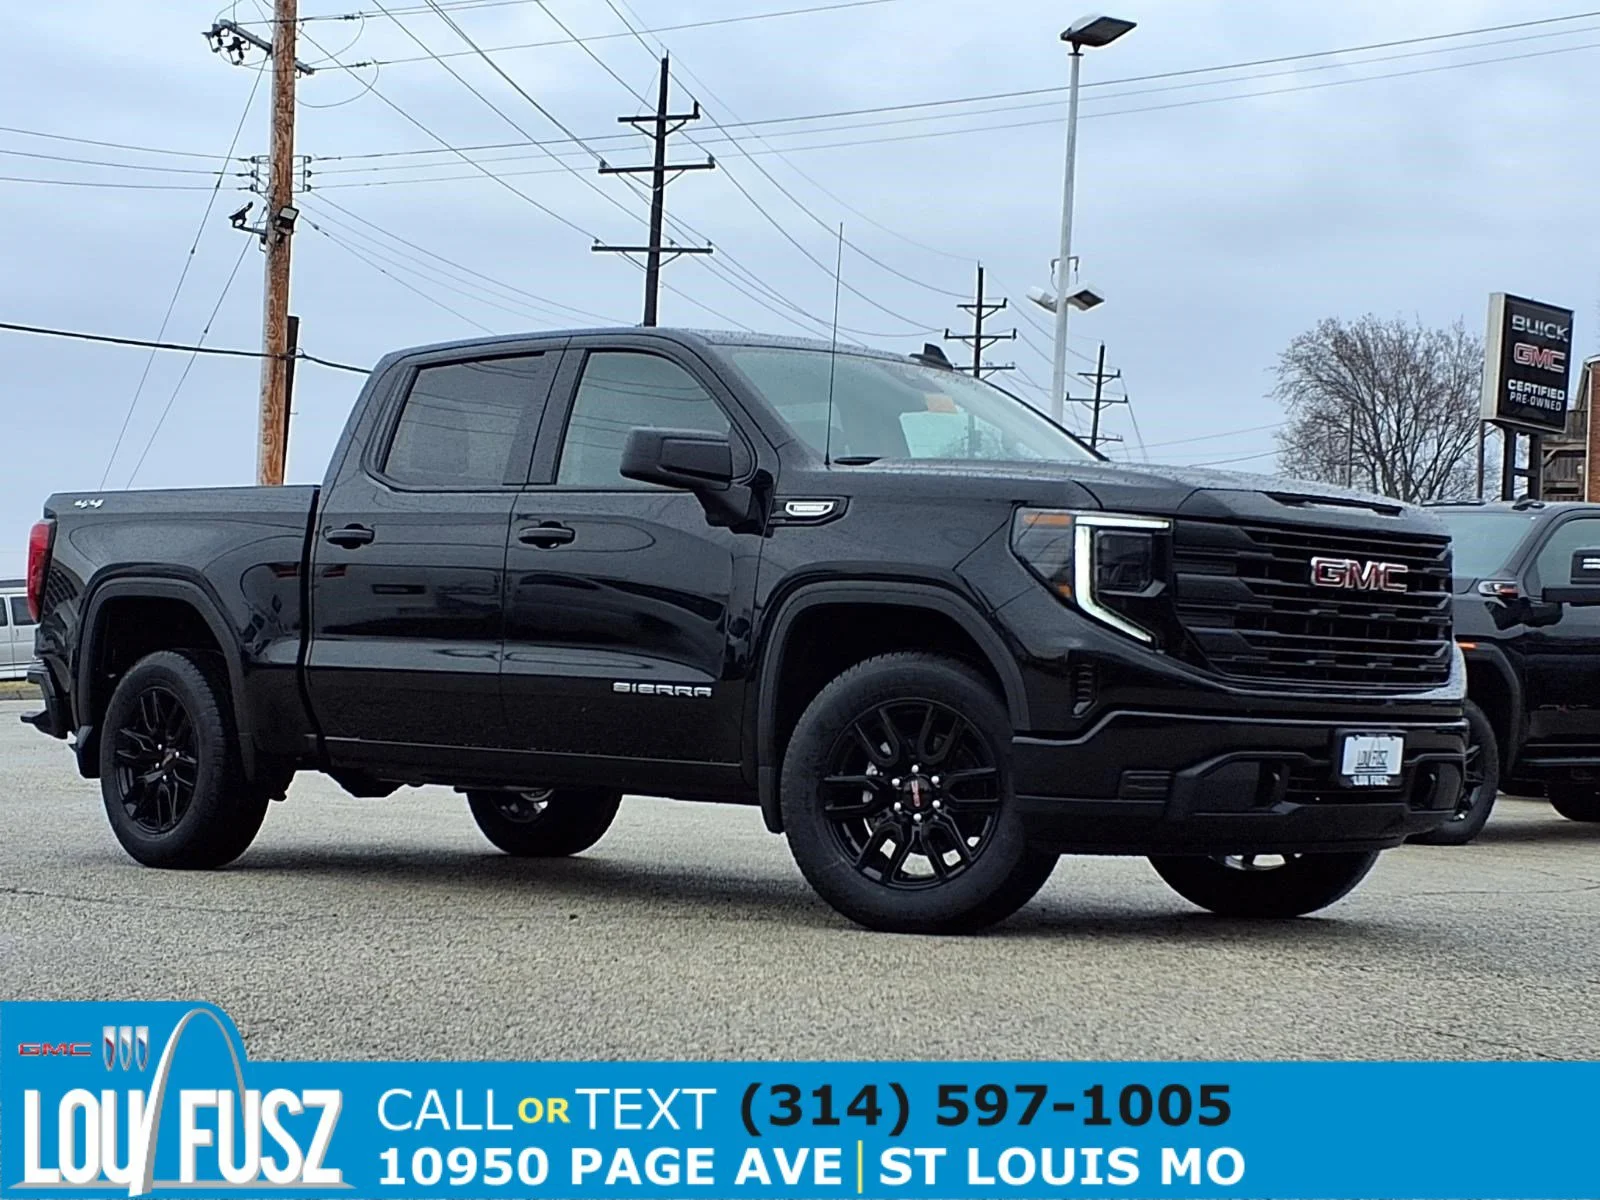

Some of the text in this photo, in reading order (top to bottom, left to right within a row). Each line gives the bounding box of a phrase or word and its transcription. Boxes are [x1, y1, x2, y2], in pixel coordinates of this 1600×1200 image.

[1511, 314, 1569, 342] BUICK
[1513, 342, 1566, 374] GMC
[1507, 379, 1565, 401] CERTIFIED
[1509, 391, 1562, 412] PRE-OWNED
[1310, 556, 1409, 593] GMC
[613, 682, 713, 697] SIERRA
